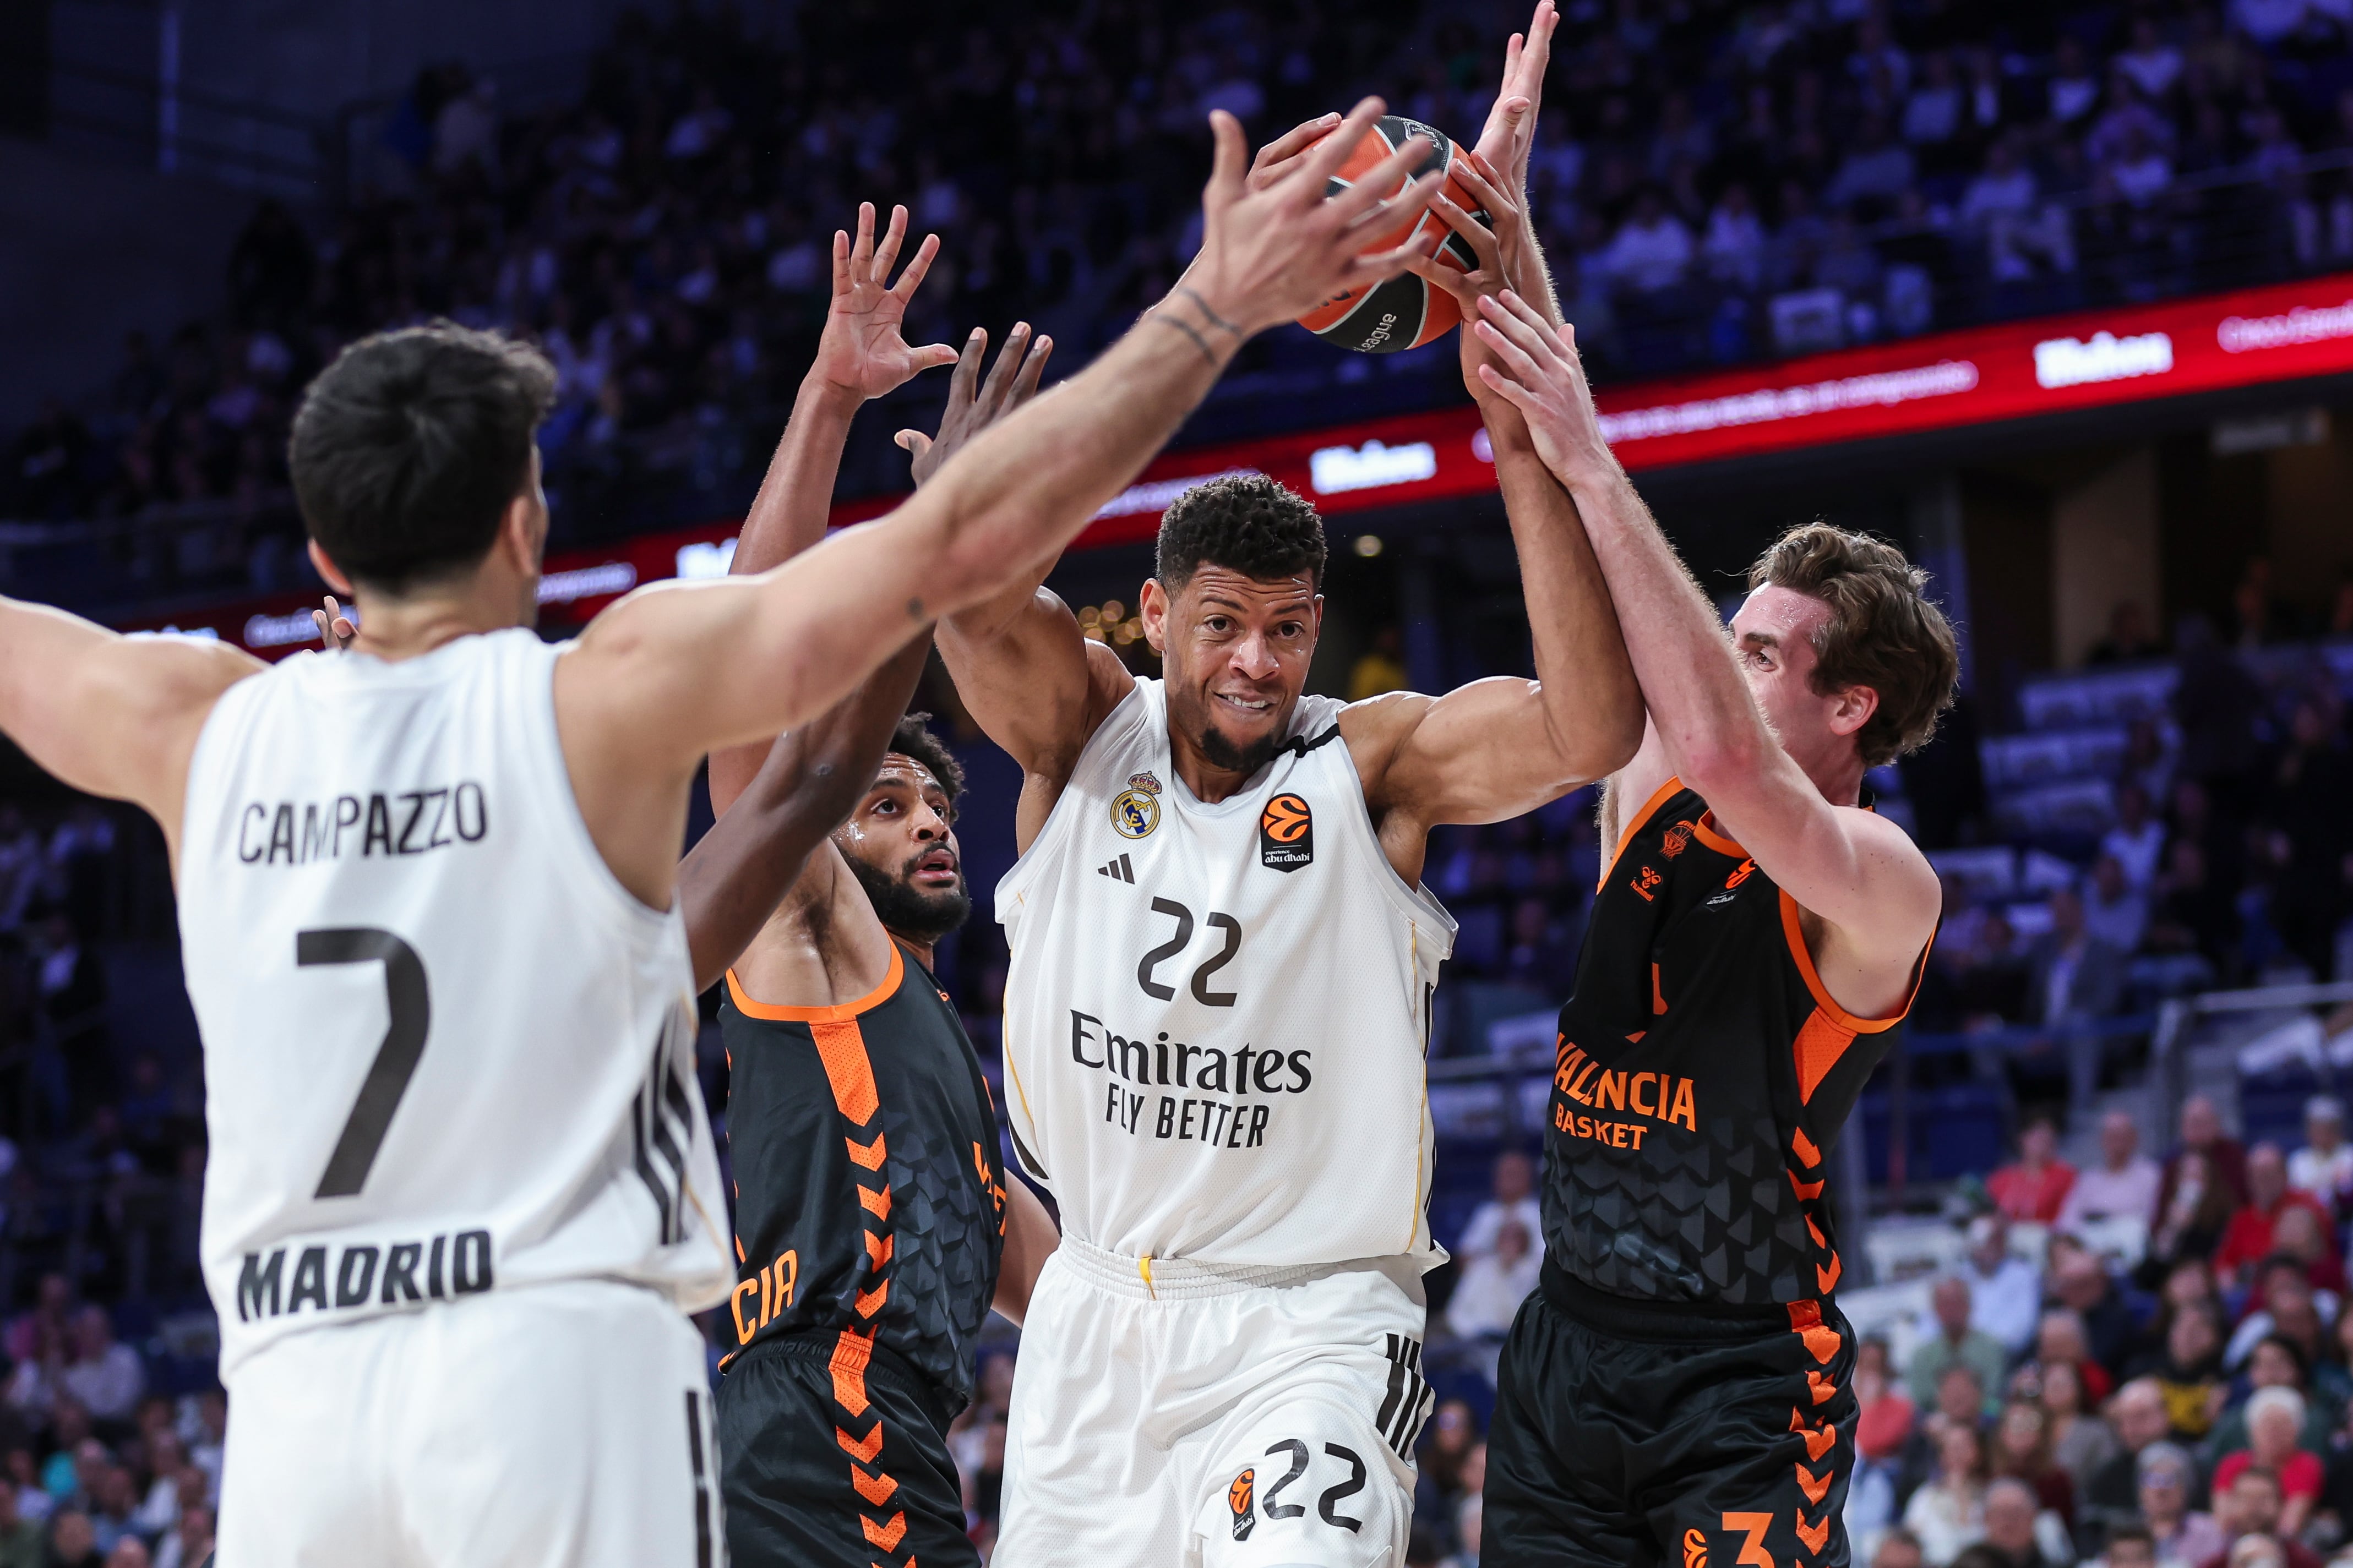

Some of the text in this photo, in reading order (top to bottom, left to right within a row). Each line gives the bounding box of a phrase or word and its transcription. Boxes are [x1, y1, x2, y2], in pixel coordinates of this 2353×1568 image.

[239, 782, 487, 864] CAMPAZZO
[1265, 853, 1310, 863] abu dhabi
[1137, 896, 1243, 1007] 22
[296, 925, 431, 1200] 7
[1070, 1009, 1312, 1094] Emirates
[1106, 1083, 1270, 1148] FLY BETTER
[1555, 1101, 1648, 1150] BASKET
[238, 1230, 493, 1323] MADRID
[1262, 1439, 1367, 1534] 22
[1722, 1511, 1775, 1568] 3
